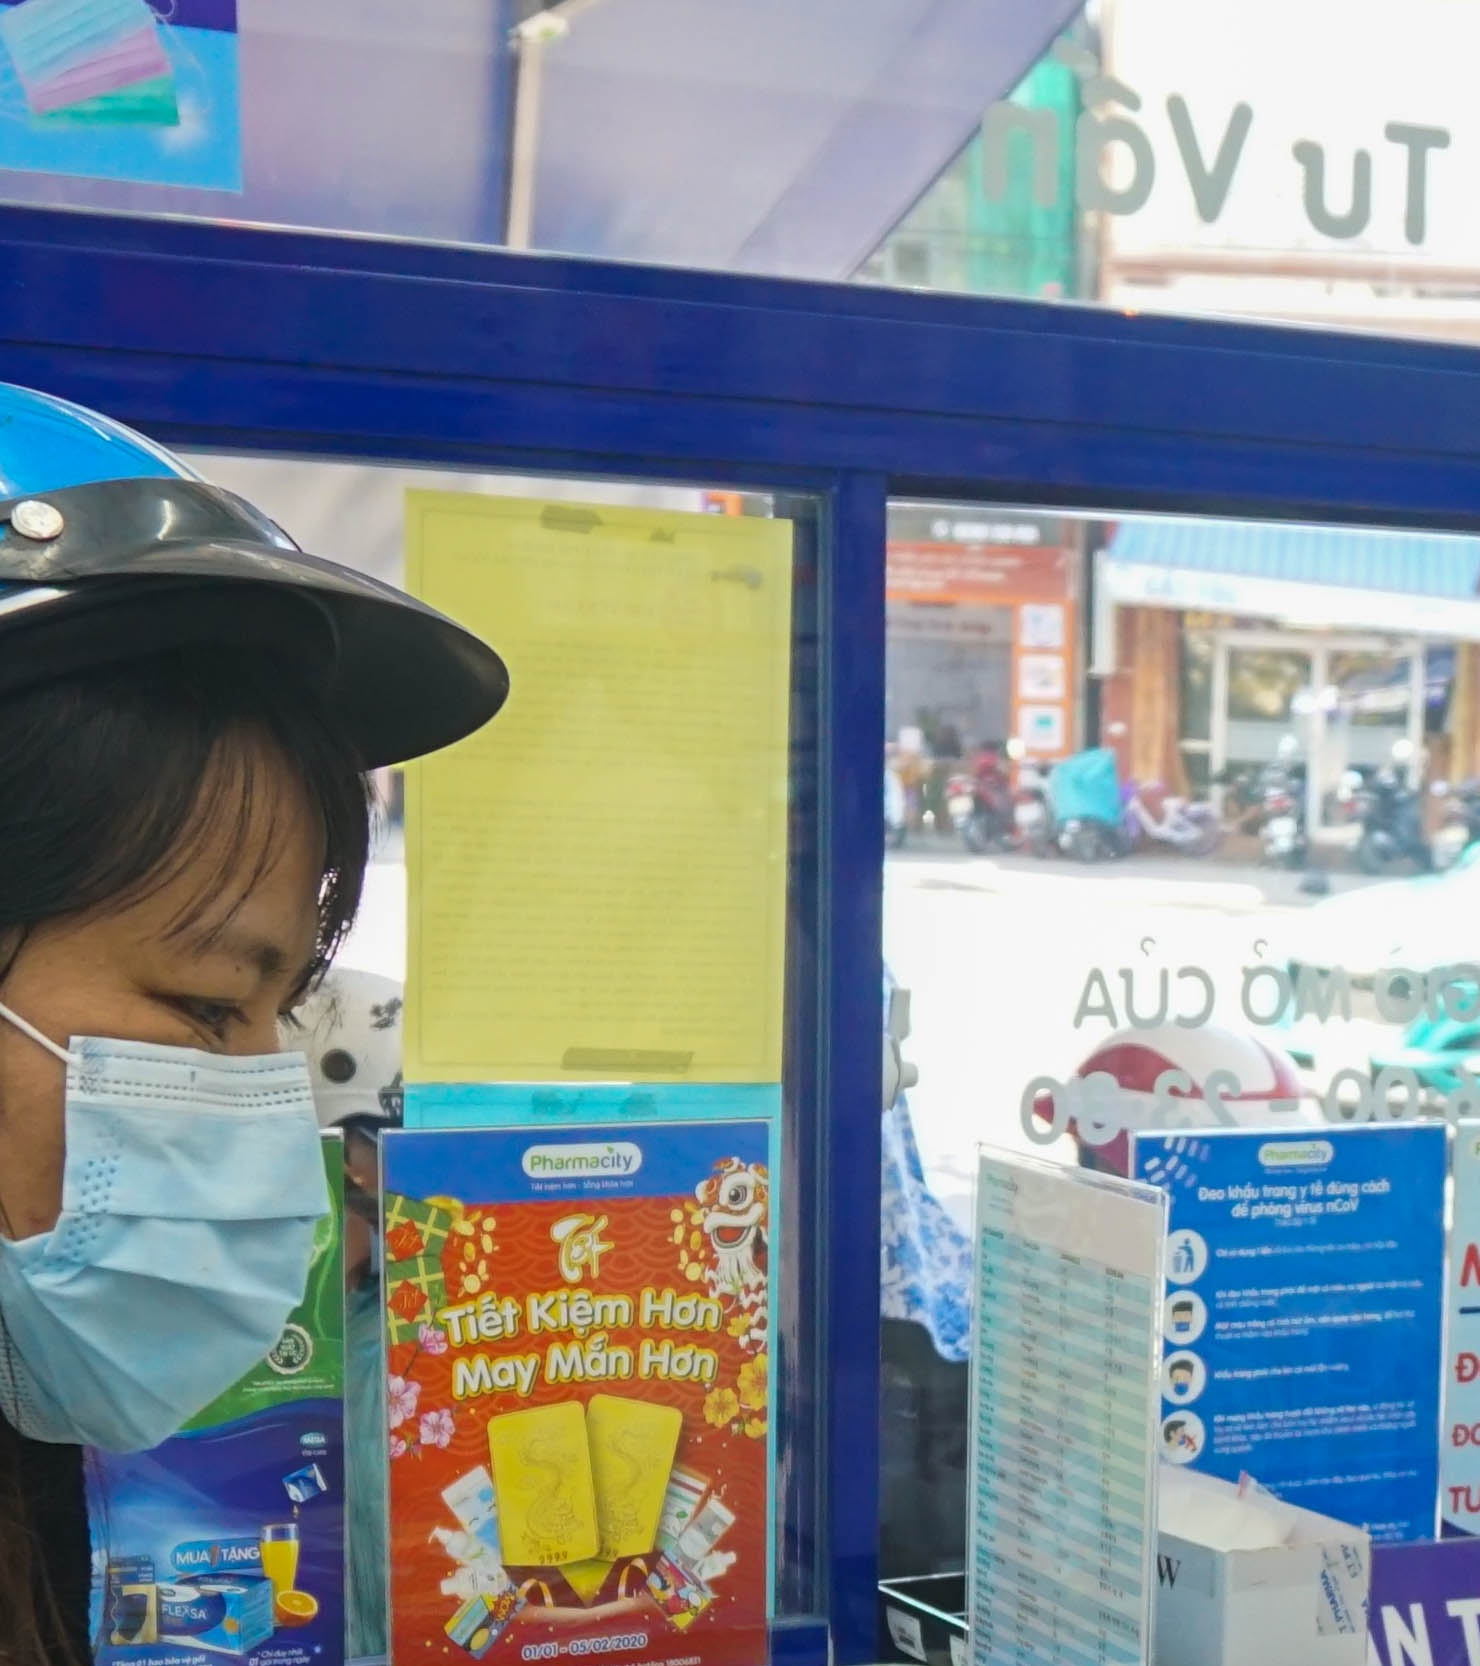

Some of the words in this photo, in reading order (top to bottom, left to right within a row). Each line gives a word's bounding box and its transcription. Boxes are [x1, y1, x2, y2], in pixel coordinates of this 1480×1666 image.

[530, 1146, 633, 1172] Pharmacity
[1262, 1184, 1296, 1200] trang
[1326, 1198, 1361, 1213] nCoV
[444, 1295, 520, 1345] Tiết
[529, 1292, 631, 1337] Kiệm
[642, 1290, 721, 1329] Hơn
[456, 1354, 537, 1397] May
[546, 1333, 630, 1381] Mắn
[642, 1341, 717, 1381] Hơn
[176, 1550, 210, 1566] MUA
[221, 1546, 260, 1563] TẶNG
[522, 1644, 559, 1661] 01/01
[570, 1633, 648, 1656] 05/02/2020
